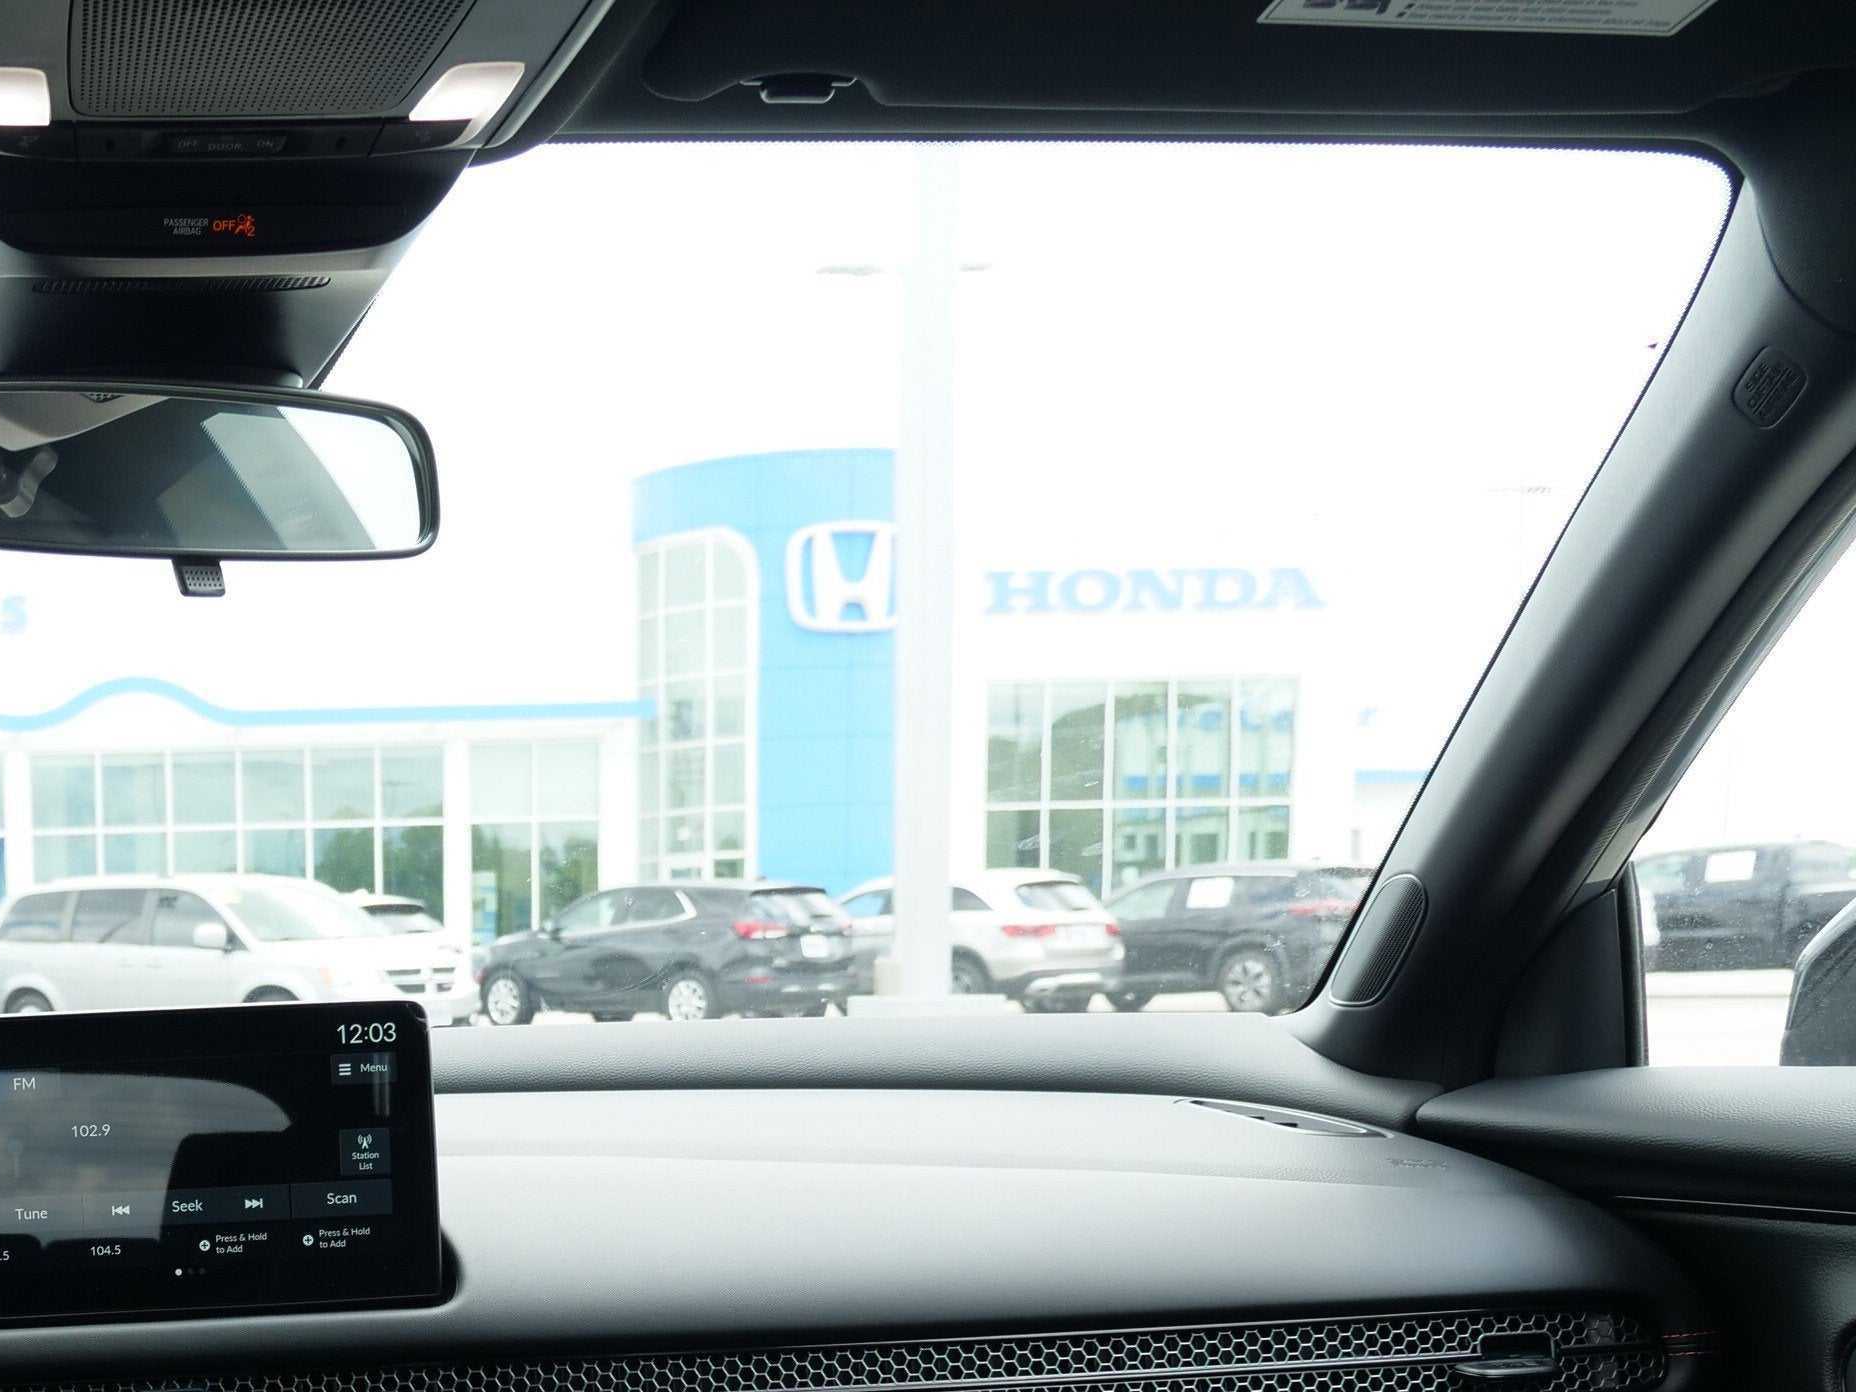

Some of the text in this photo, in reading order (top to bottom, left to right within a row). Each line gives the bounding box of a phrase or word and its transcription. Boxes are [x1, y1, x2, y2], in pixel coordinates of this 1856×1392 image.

[164, 218, 209, 227] PASSENGER
[213, 220, 235, 231] OFF
[173, 227, 201, 235] AIRBAG
[984, 566, 1326, 616] HONDA
[336, 1022, 397, 1045] 12:03
[360, 1061, 388, 1074] Menu
[13, 1077, 37, 1091] FM
[71, 1124, 111, 1138] 102.9
[352, 1151, 380, 1161] Station
[359, 1161, 373, 1171] List
[326, 1191, 357, 1205] Scan
[172, 1199, 203, 1213] Seek
[15, 1207, 48, 1221] Tune
[215, 1232, 267, 1244] Press & Hold
[319, 1227, 370, 1239] Press & Hold
[216, 1244, 243, 1253] to Add
[319, 1238, 346, 1248] to Add
[90, 1244, 122, 1257] 104.5
